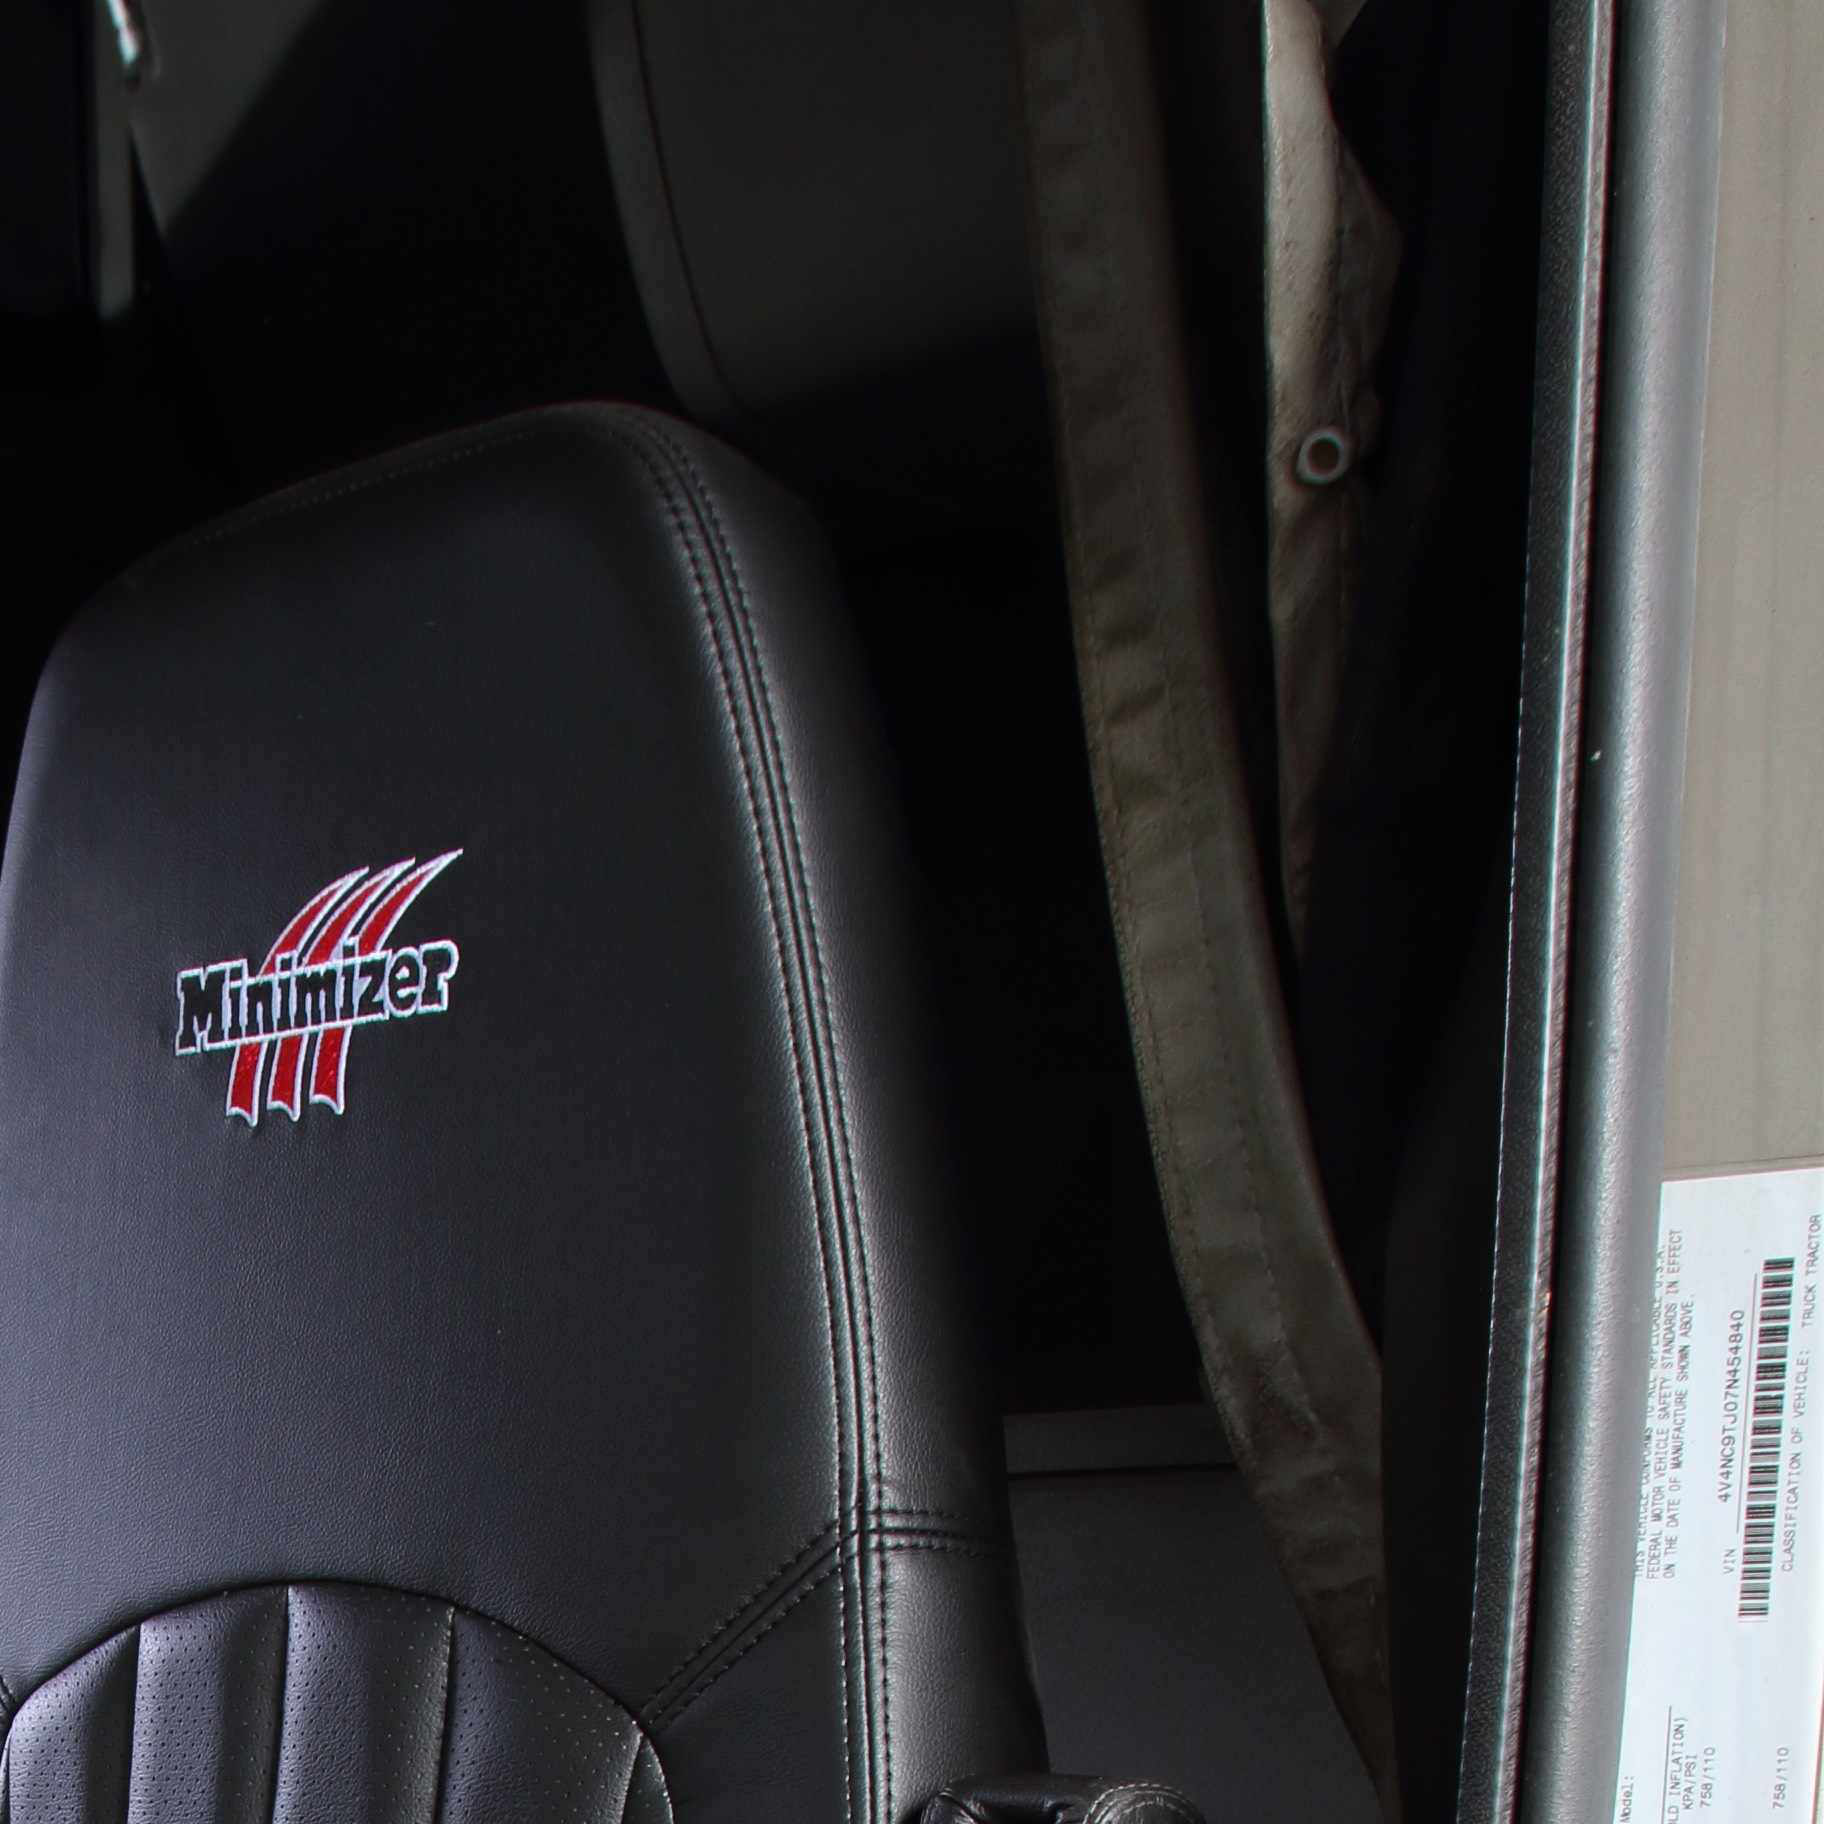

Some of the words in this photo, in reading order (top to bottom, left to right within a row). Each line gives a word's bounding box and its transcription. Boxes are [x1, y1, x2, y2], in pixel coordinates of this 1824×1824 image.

[176, 937, 459, 1056] Minimizer
[1666, 1229, 1682, 1273] EFFECT
[1804, 1214, 1819, 1276] TRACTOR
[1665, 1279, 1679, 1294] IN
[1800, 1284, 1816, 1328] TRUCK
[1660, 1302, 1677, 1369] STANDARDS
[1657, 1376, 1671, 1419] SAFETY
[1717, 1309, 1744, 1502] 4V4NC9TJ07N454840
[1792, 1350, 1809, 1418] VEHICLE:
[1654, 1428, 1669, 1478] VEHICLE
[1670, 1389, 1688, 1469] MANUFACTURE
[1790, 1427, 1803, 1444] OF
[1650, 1485, 1665, 1522] MOTOR
[1668, 1477, 1680, 1491] OF
[1665, 1498, 1680, 1527] DATE
[1781, 1451, 1802, 1572] CLASSIFICATION
[1646, 1530, 1662, 1579] FEDERAL
[1663, 1535, 1677, 1555] THE
[1723, 1548, 1735, 1574] VIN
[1662, 1563, 1675, 1578] ON
[1668, 1717, 1688, 1795] INFLATION)
[1699, 1746, 1715, 1808] 758/110
[1772, 1747, 1789, 1808] 758/110
[1619, 1776, 1633, 1823] Model:
[1681, 1754, 1697, 1810] KPA/PSI
